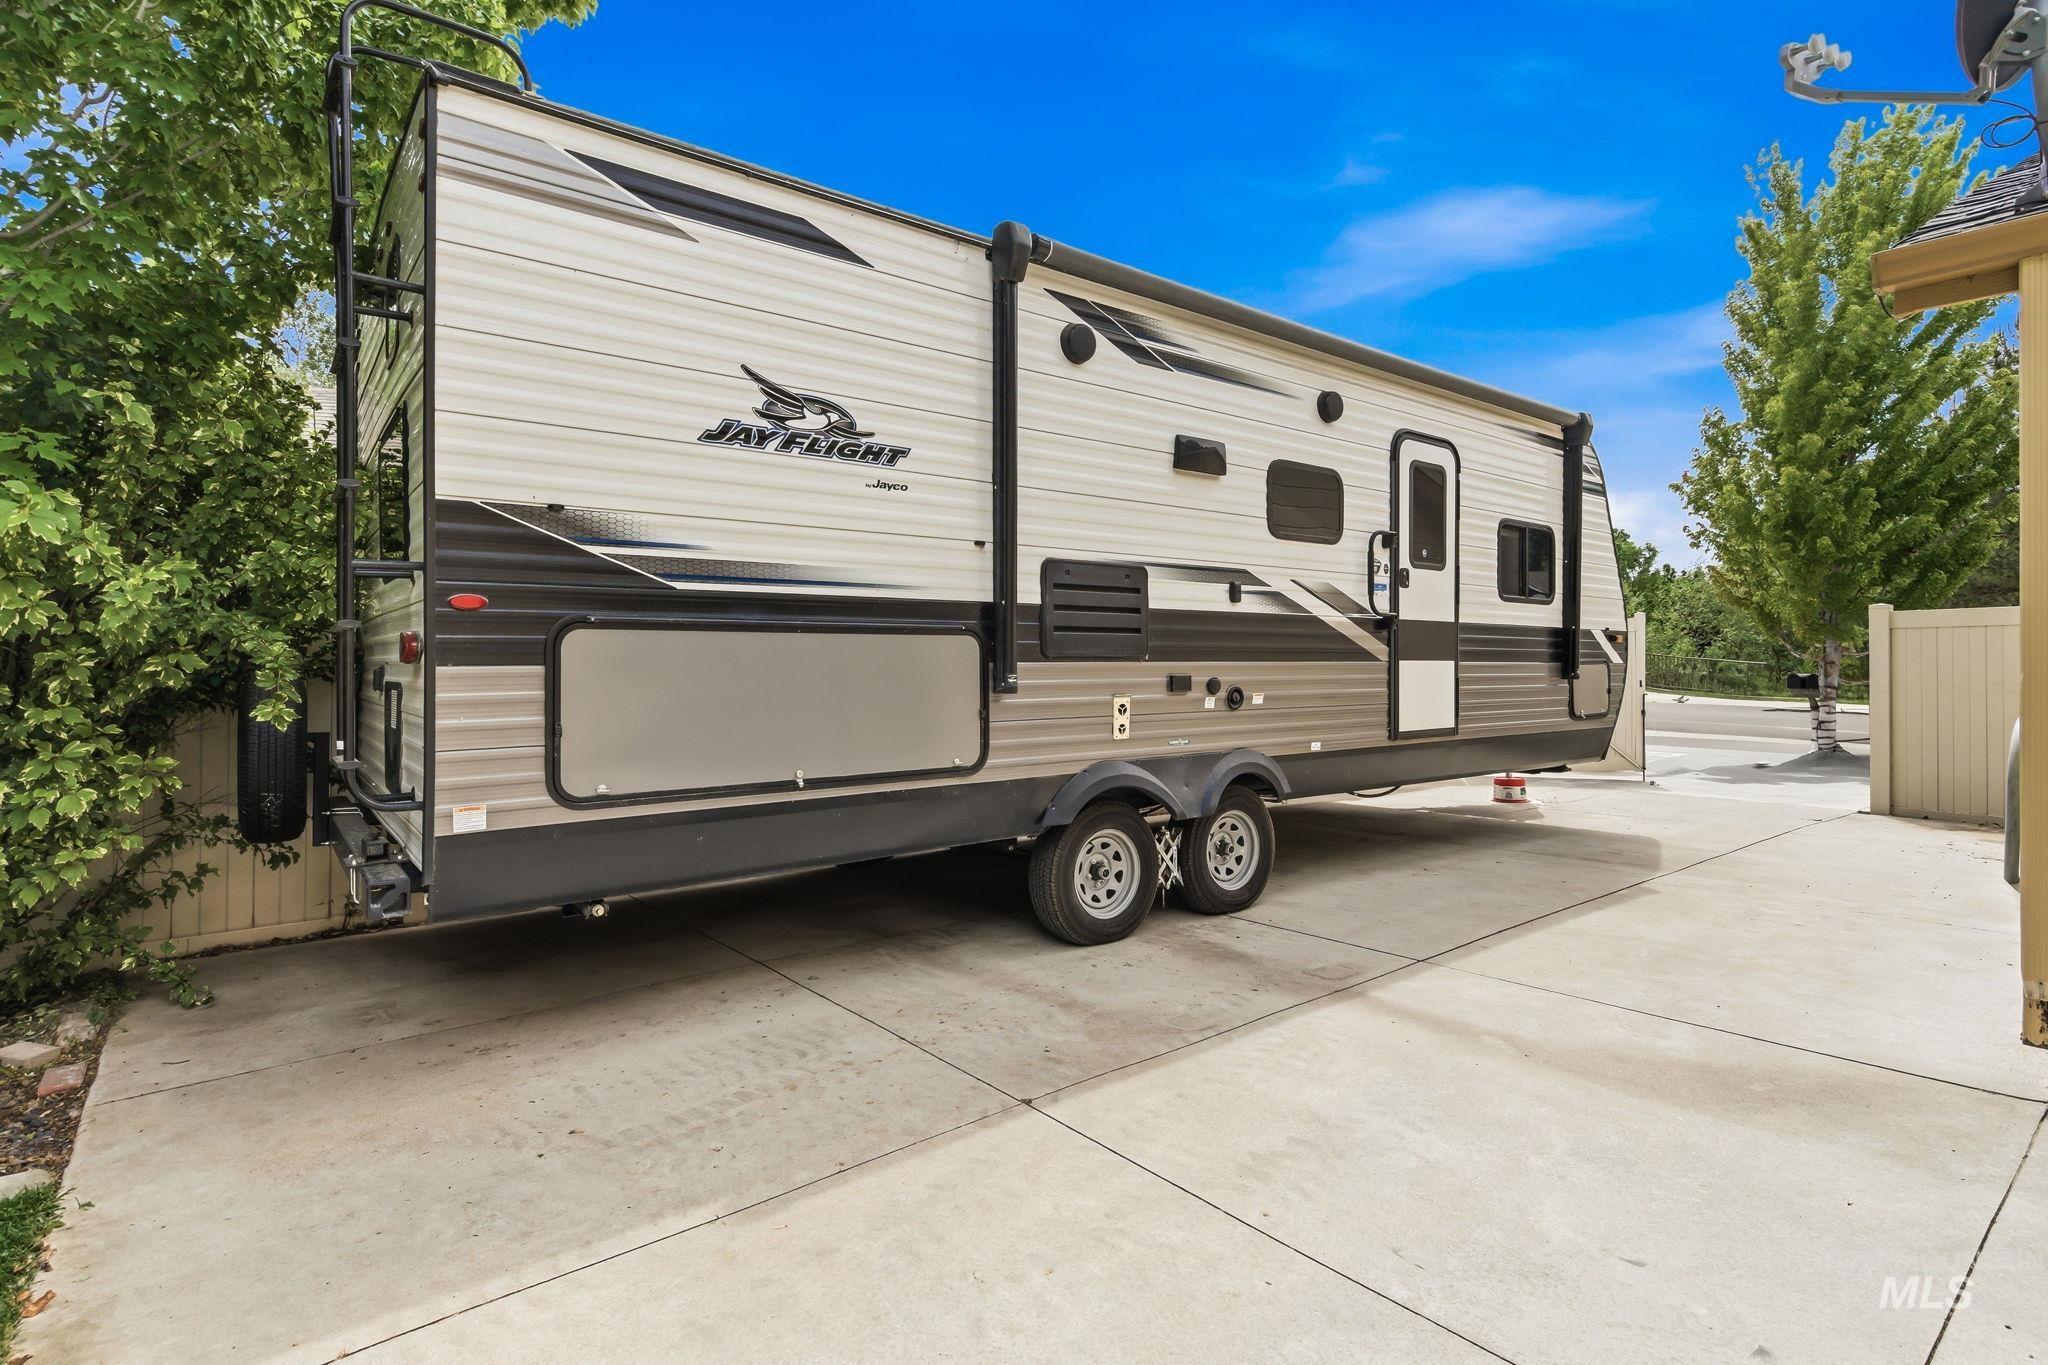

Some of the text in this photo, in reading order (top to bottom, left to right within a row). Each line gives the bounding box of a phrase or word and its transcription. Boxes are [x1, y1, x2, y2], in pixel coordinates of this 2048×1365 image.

[697, 418, 912, 467] JAY FLIGHT
[872, 479, 909, 491] Jayco
